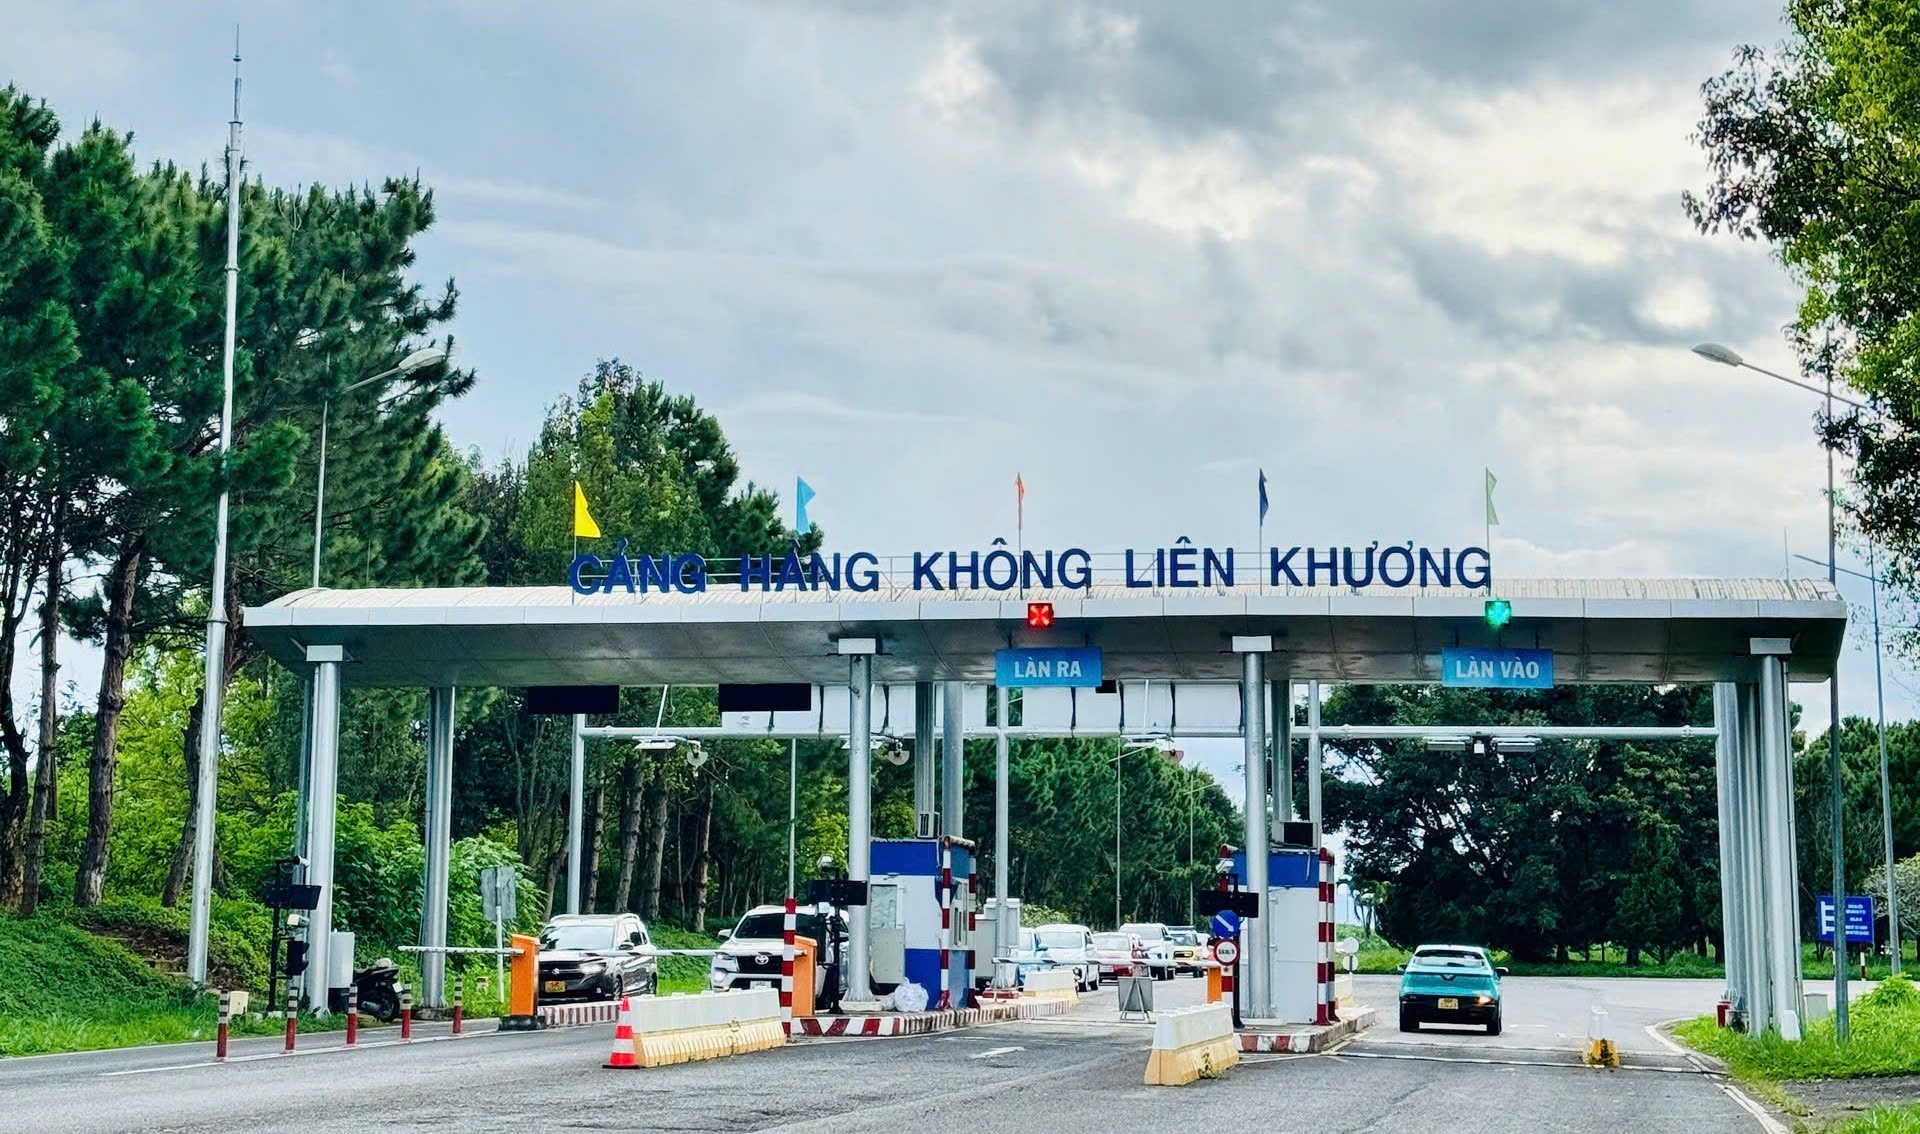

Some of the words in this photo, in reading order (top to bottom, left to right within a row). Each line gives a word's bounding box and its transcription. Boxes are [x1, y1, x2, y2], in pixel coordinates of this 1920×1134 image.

[569, 537, 707, 595] CẢNG
[740, 539, 879, 592] HÀNG
[913, 537, 1092, 591] KHÔNG
[1126, 536, 1234, 588] LIÊN
[1270, 540, 1491, 589] KHƯƠNG
[1014, 656, 1050, 678] LÀN
[1057, 660, 1082, 678] RA
[1456, 655, 1494, 678] LÀN
[1500, 656, 1540, 679] VÀO
